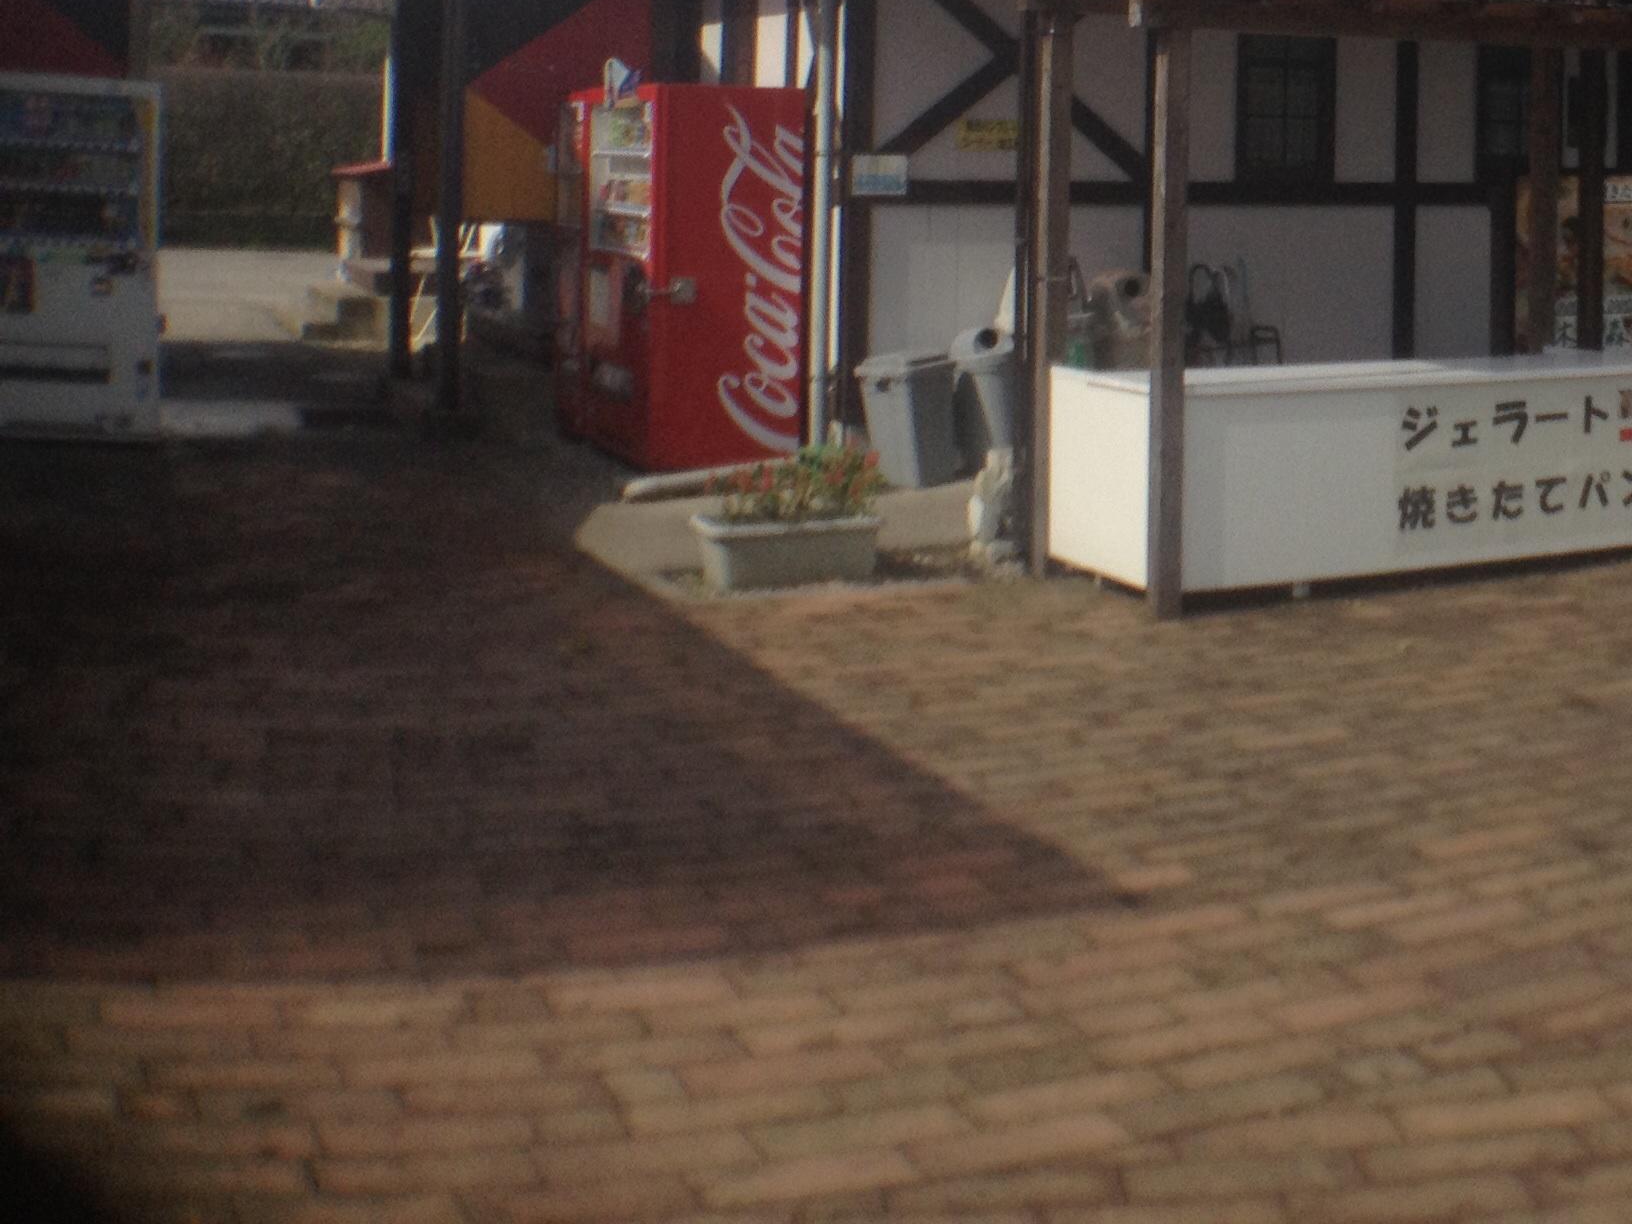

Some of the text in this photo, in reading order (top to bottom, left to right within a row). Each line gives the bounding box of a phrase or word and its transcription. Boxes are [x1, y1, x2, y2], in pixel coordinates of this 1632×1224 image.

[718, 101, 804, 456] Coca-Cola
[1401, 394, 1609, 451] ジェラート
